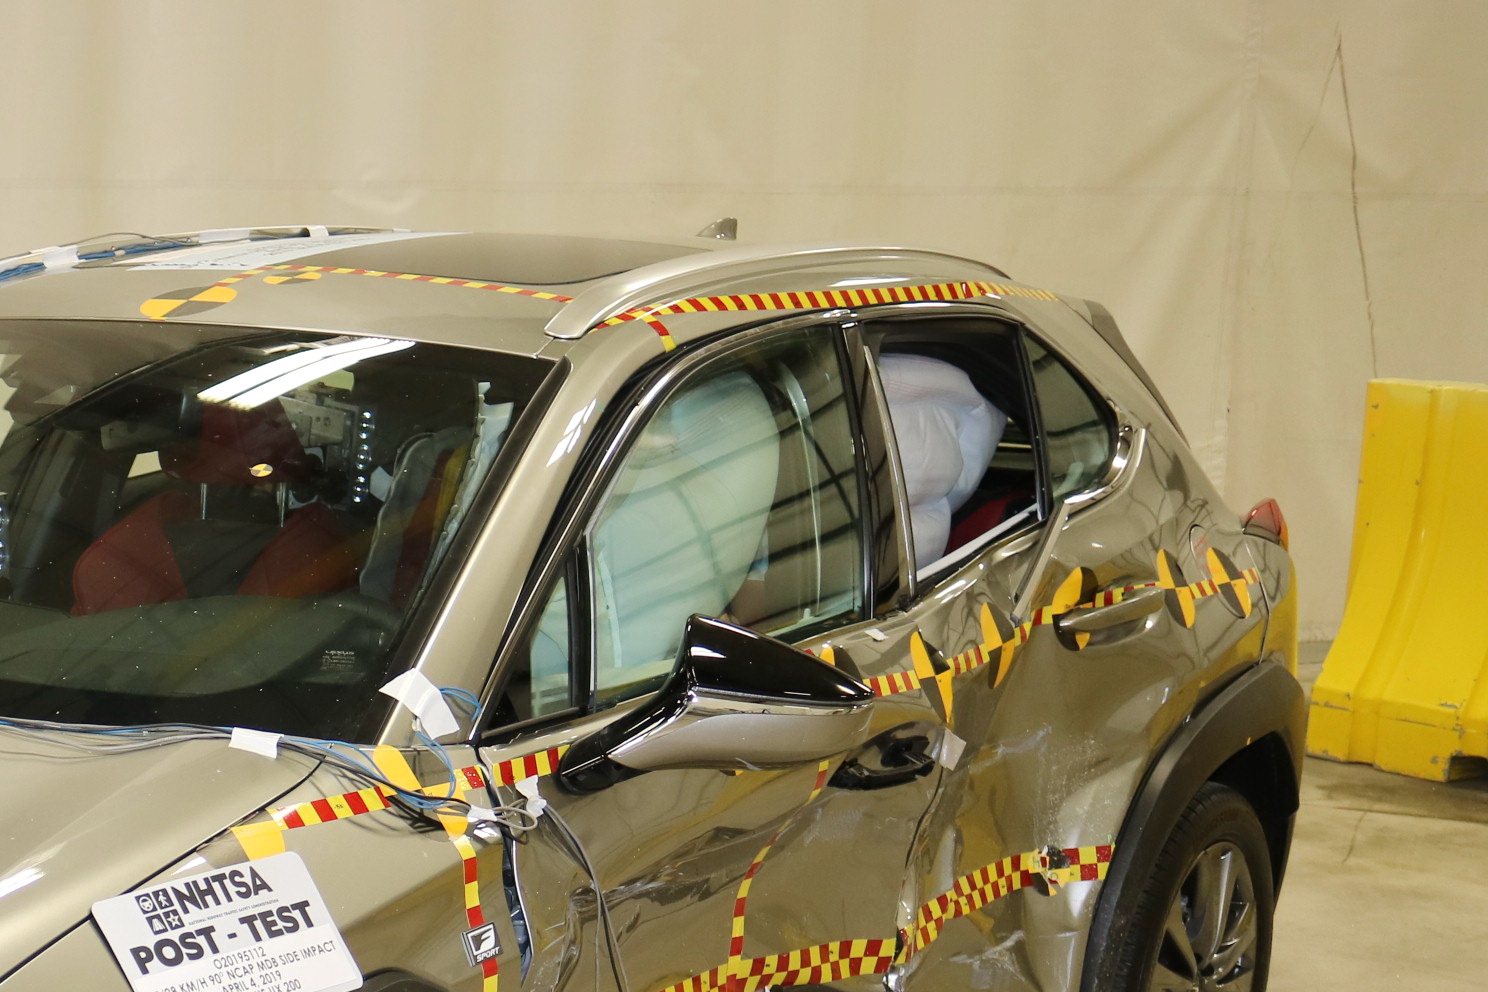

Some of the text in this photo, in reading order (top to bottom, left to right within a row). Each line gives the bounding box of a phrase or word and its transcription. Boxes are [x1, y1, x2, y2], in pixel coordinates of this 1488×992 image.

[170, 866, 274, 915] NHTSA
[129, 925, 220, 975] POST
[238, 900, 314, 943] TEST
[208, 971, 224, 986] 90°
[226, 963, 254, 981] NCAP
[256, 957, 279, 972] MDB
[278, 951, 300, 966] SIDE
[299, 940, 336, 960] IMPACT
[476, 946, 500, 963] SPORT
[250, 977, 260, 988] 4,
[259, 970, 282, 986] 2019
[283, 978, 302, 992] 200
